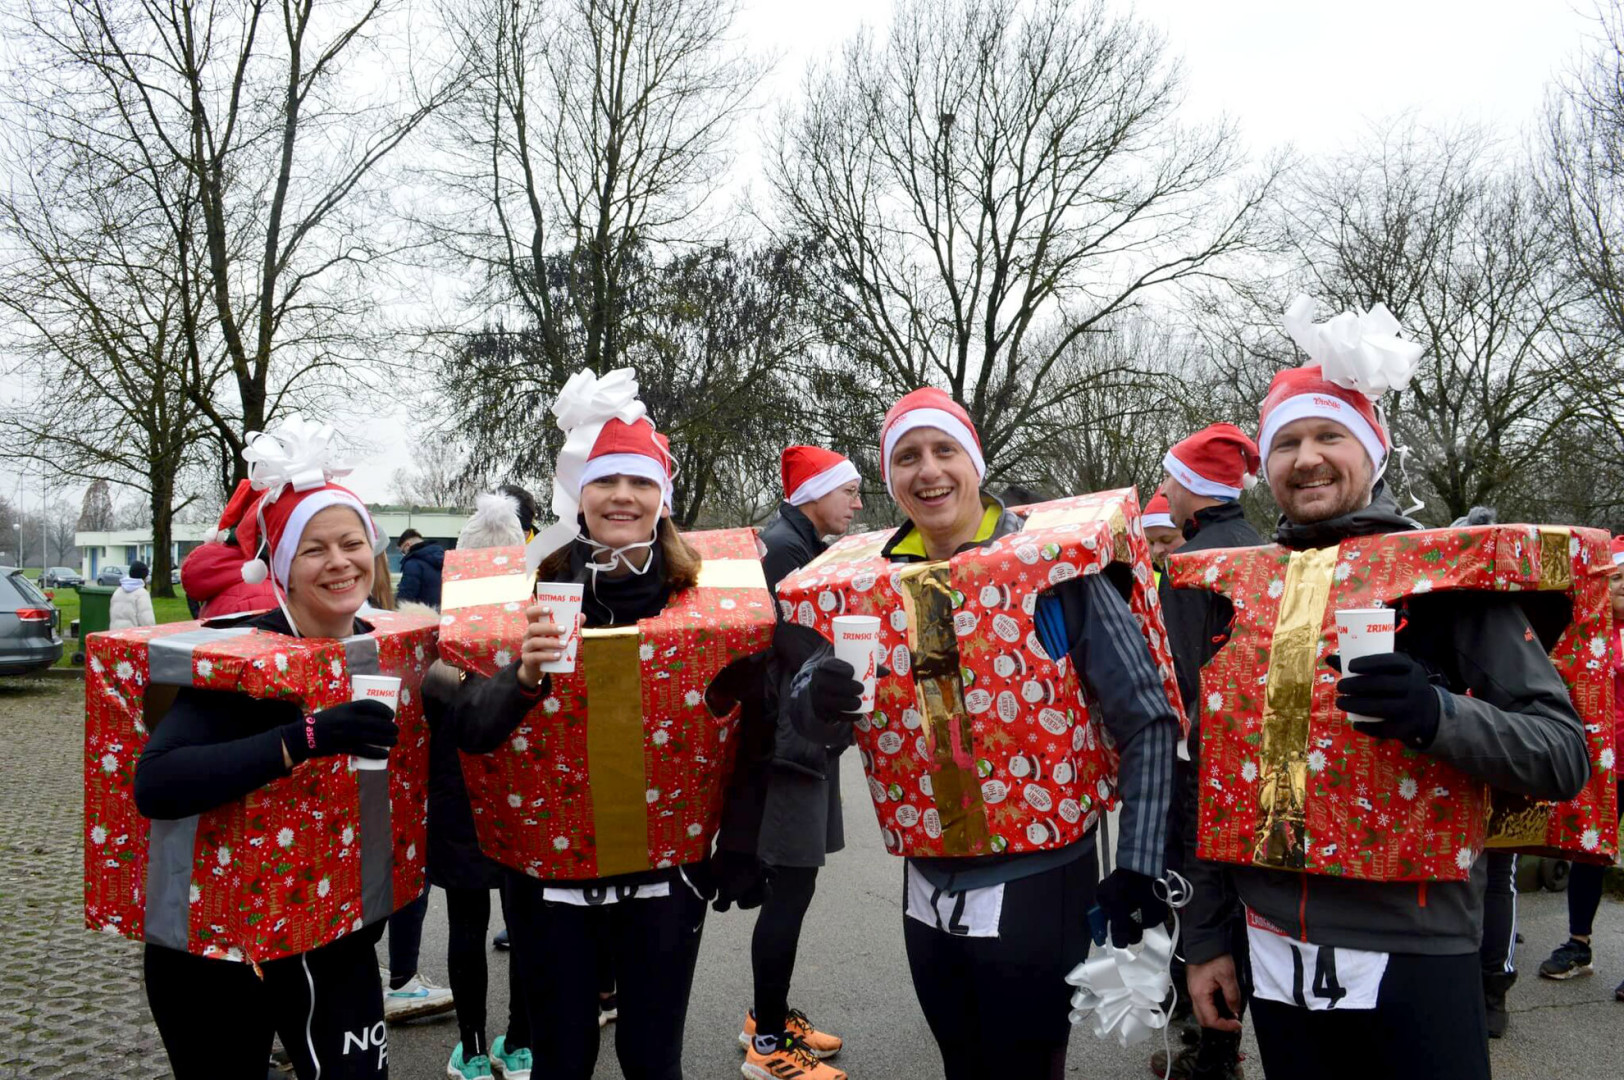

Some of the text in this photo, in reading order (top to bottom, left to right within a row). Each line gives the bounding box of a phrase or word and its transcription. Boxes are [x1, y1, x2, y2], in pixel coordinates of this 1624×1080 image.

[1377, 543, 1397, 582] bright
[842, 632, 873, 641] ZRINSKI
[1366, 624, 1395, 633] ZRINS
[716, 634, 726, 669] ristmas
[1230, 640, 1245, 672] Merry
[1239, 629, 1259, 684] Christmas
[366, 688, 395, 698] ZRINSKI
[657, 683, 667, 710] Merry
[669, 672, 680, 717] Christmas
[1317, 689, 1332, 722] Merry
[1576, 671, 1590, 716] Christm
[1588, 684, 1601, 718] Merry
[305, 726, 317, 749] asics
[1355, 736, 1374, 777] bright
[1229, 816, 1241, 862] ristmas
[1386, 838, 1400, 880] istmas
[119, 863, 130, 914] Christmas
[267, 883, 282, 918] bright
[292, 914, 303, 954] Christm
[342, 1020, 388, 1055] NO
